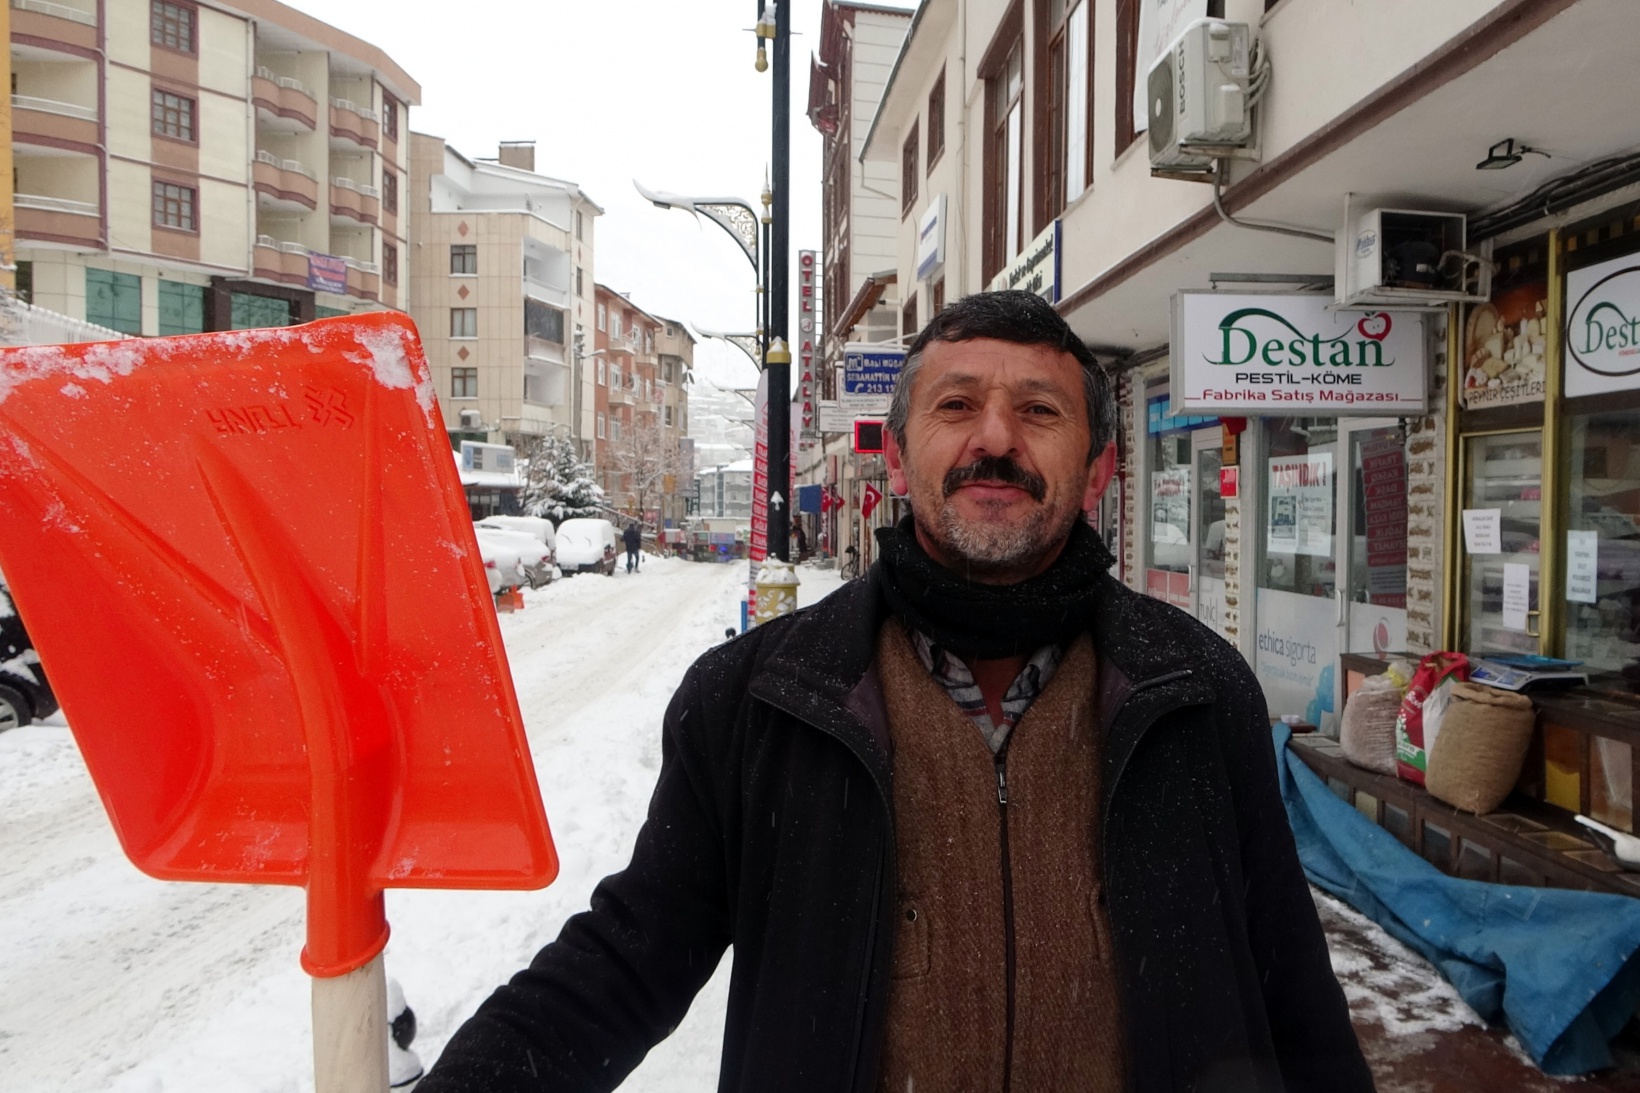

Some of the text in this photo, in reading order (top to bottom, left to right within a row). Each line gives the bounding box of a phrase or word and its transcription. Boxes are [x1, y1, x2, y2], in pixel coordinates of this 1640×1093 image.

[1178, 39, 1186, 115] BOSCH
[801, 252, 813, 313] OTEL
[1216, 310, 1390, 366] Destan
[1583, 304, 1640, 354] Dest
[801, 339, 813, 429] ATALAY
[1202, 388, 1399, 404] Fabrika Satış Mağazası
[1235, 370, 1363, 385] PESTİL-KÖME
[1258, 627, 1317, 667] ethica sigorta
